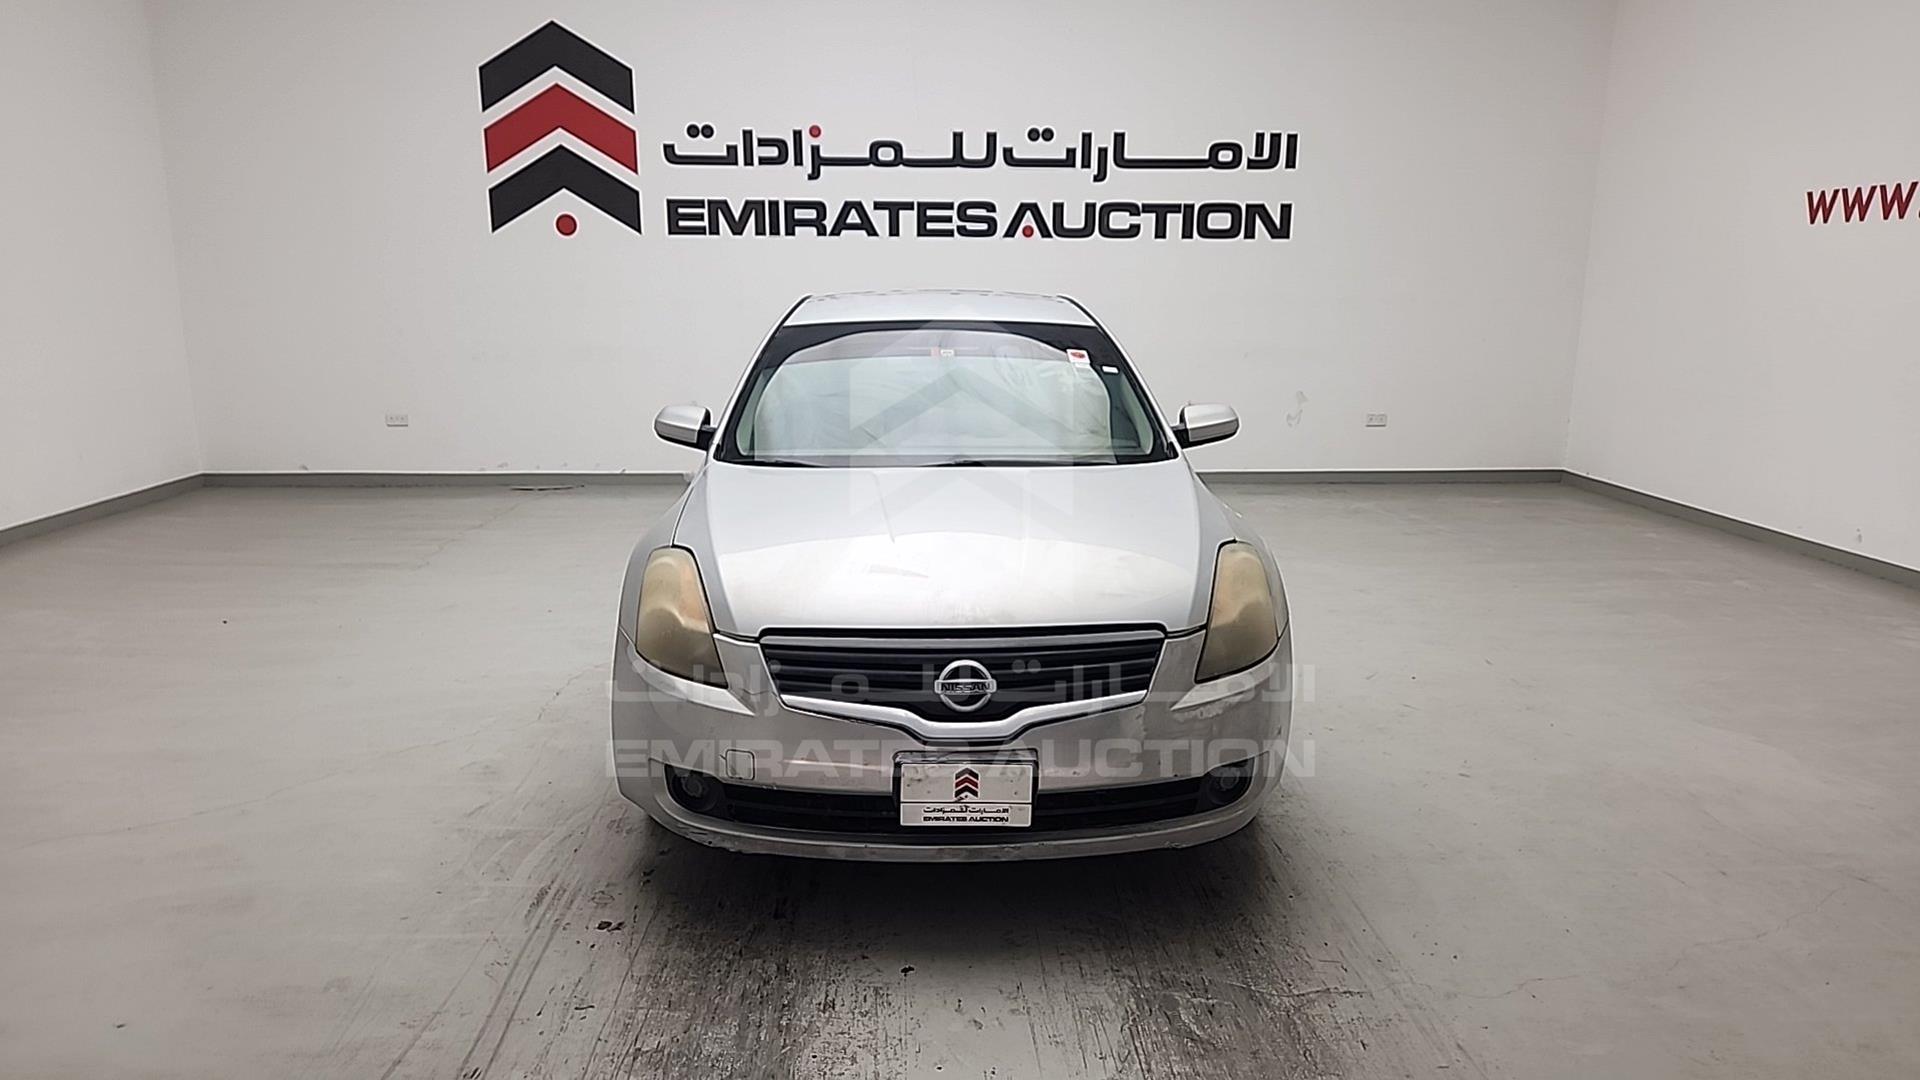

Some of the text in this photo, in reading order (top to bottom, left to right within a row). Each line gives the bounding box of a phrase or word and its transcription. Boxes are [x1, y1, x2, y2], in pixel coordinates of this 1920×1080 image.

[663, 124, 997, 180] للمزادات
[666, 199, 1293, 240] EMIRATES AUCTION
[1807, 181, 1920, 225] WWW
[942, 682, 990, 692] NISSAN
